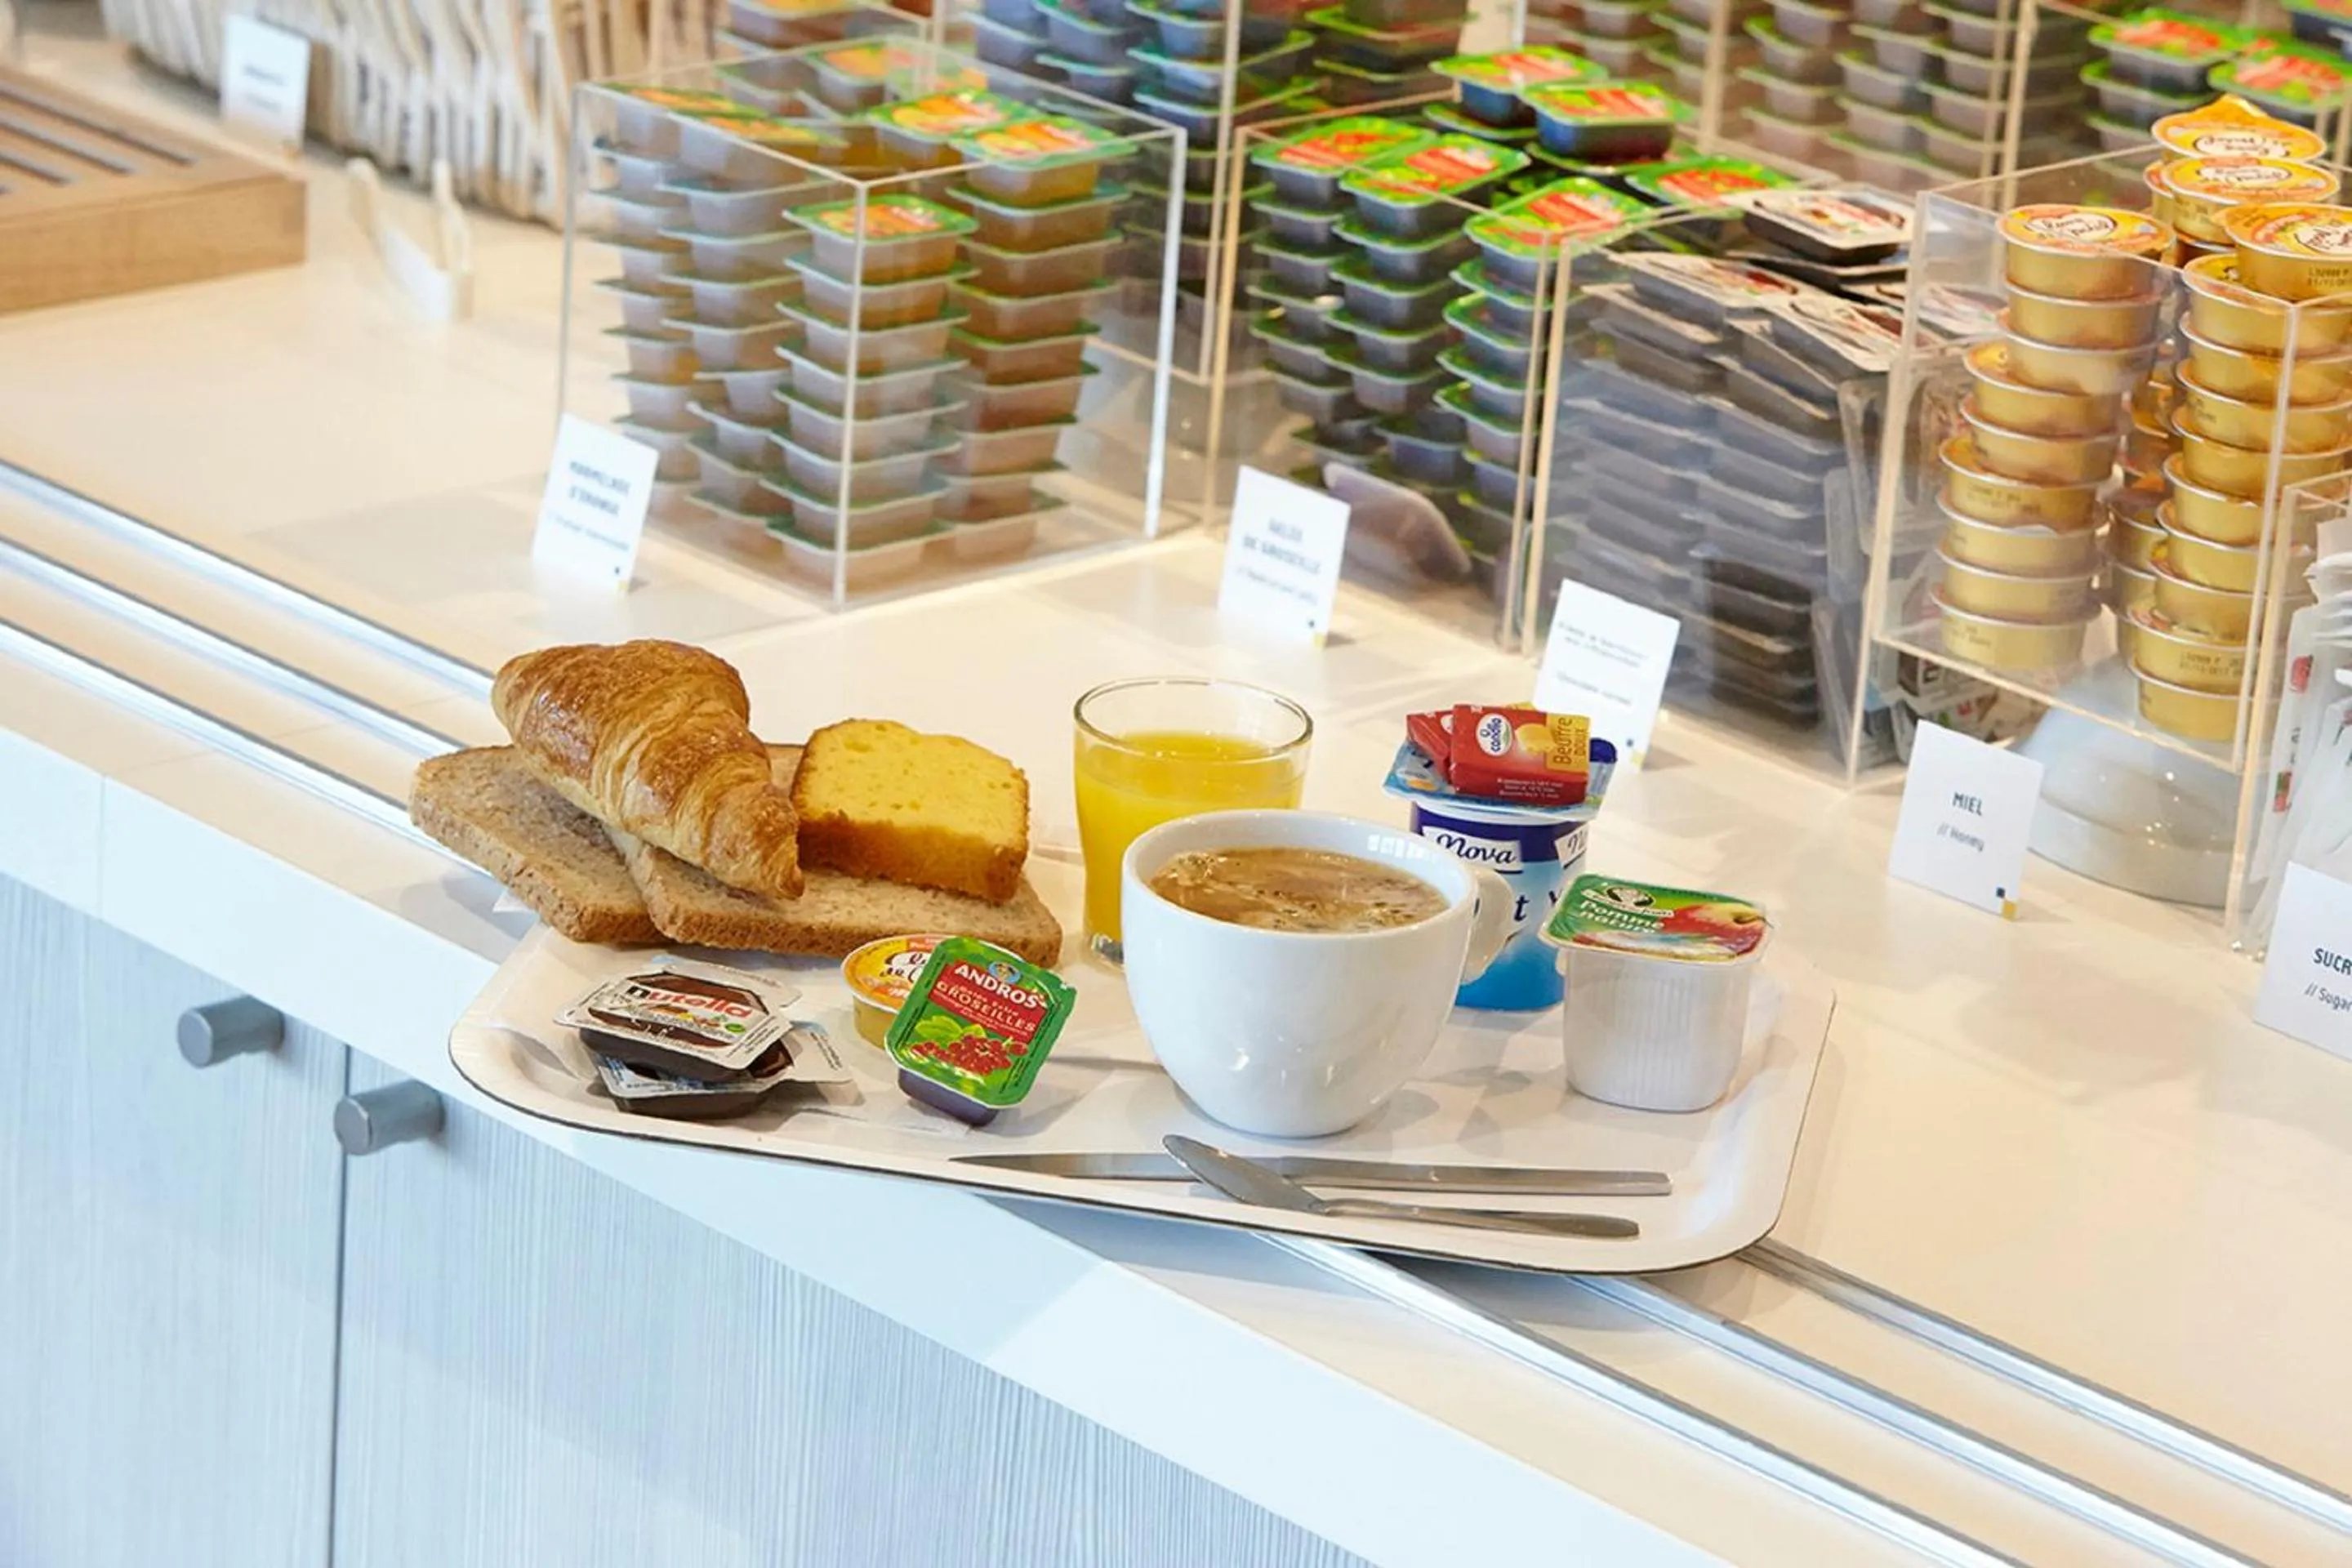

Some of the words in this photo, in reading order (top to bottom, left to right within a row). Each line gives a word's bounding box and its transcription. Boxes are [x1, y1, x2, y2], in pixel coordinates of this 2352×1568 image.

[1552, 716, 1574, 765] Beurre
[1952, 791, 1984, 817] MIEL
[1437, 832, 1517, 865] Nova
[1949, 826, 1984, 853] Honey
[954, 964, 1039, 1009] ANDROS
